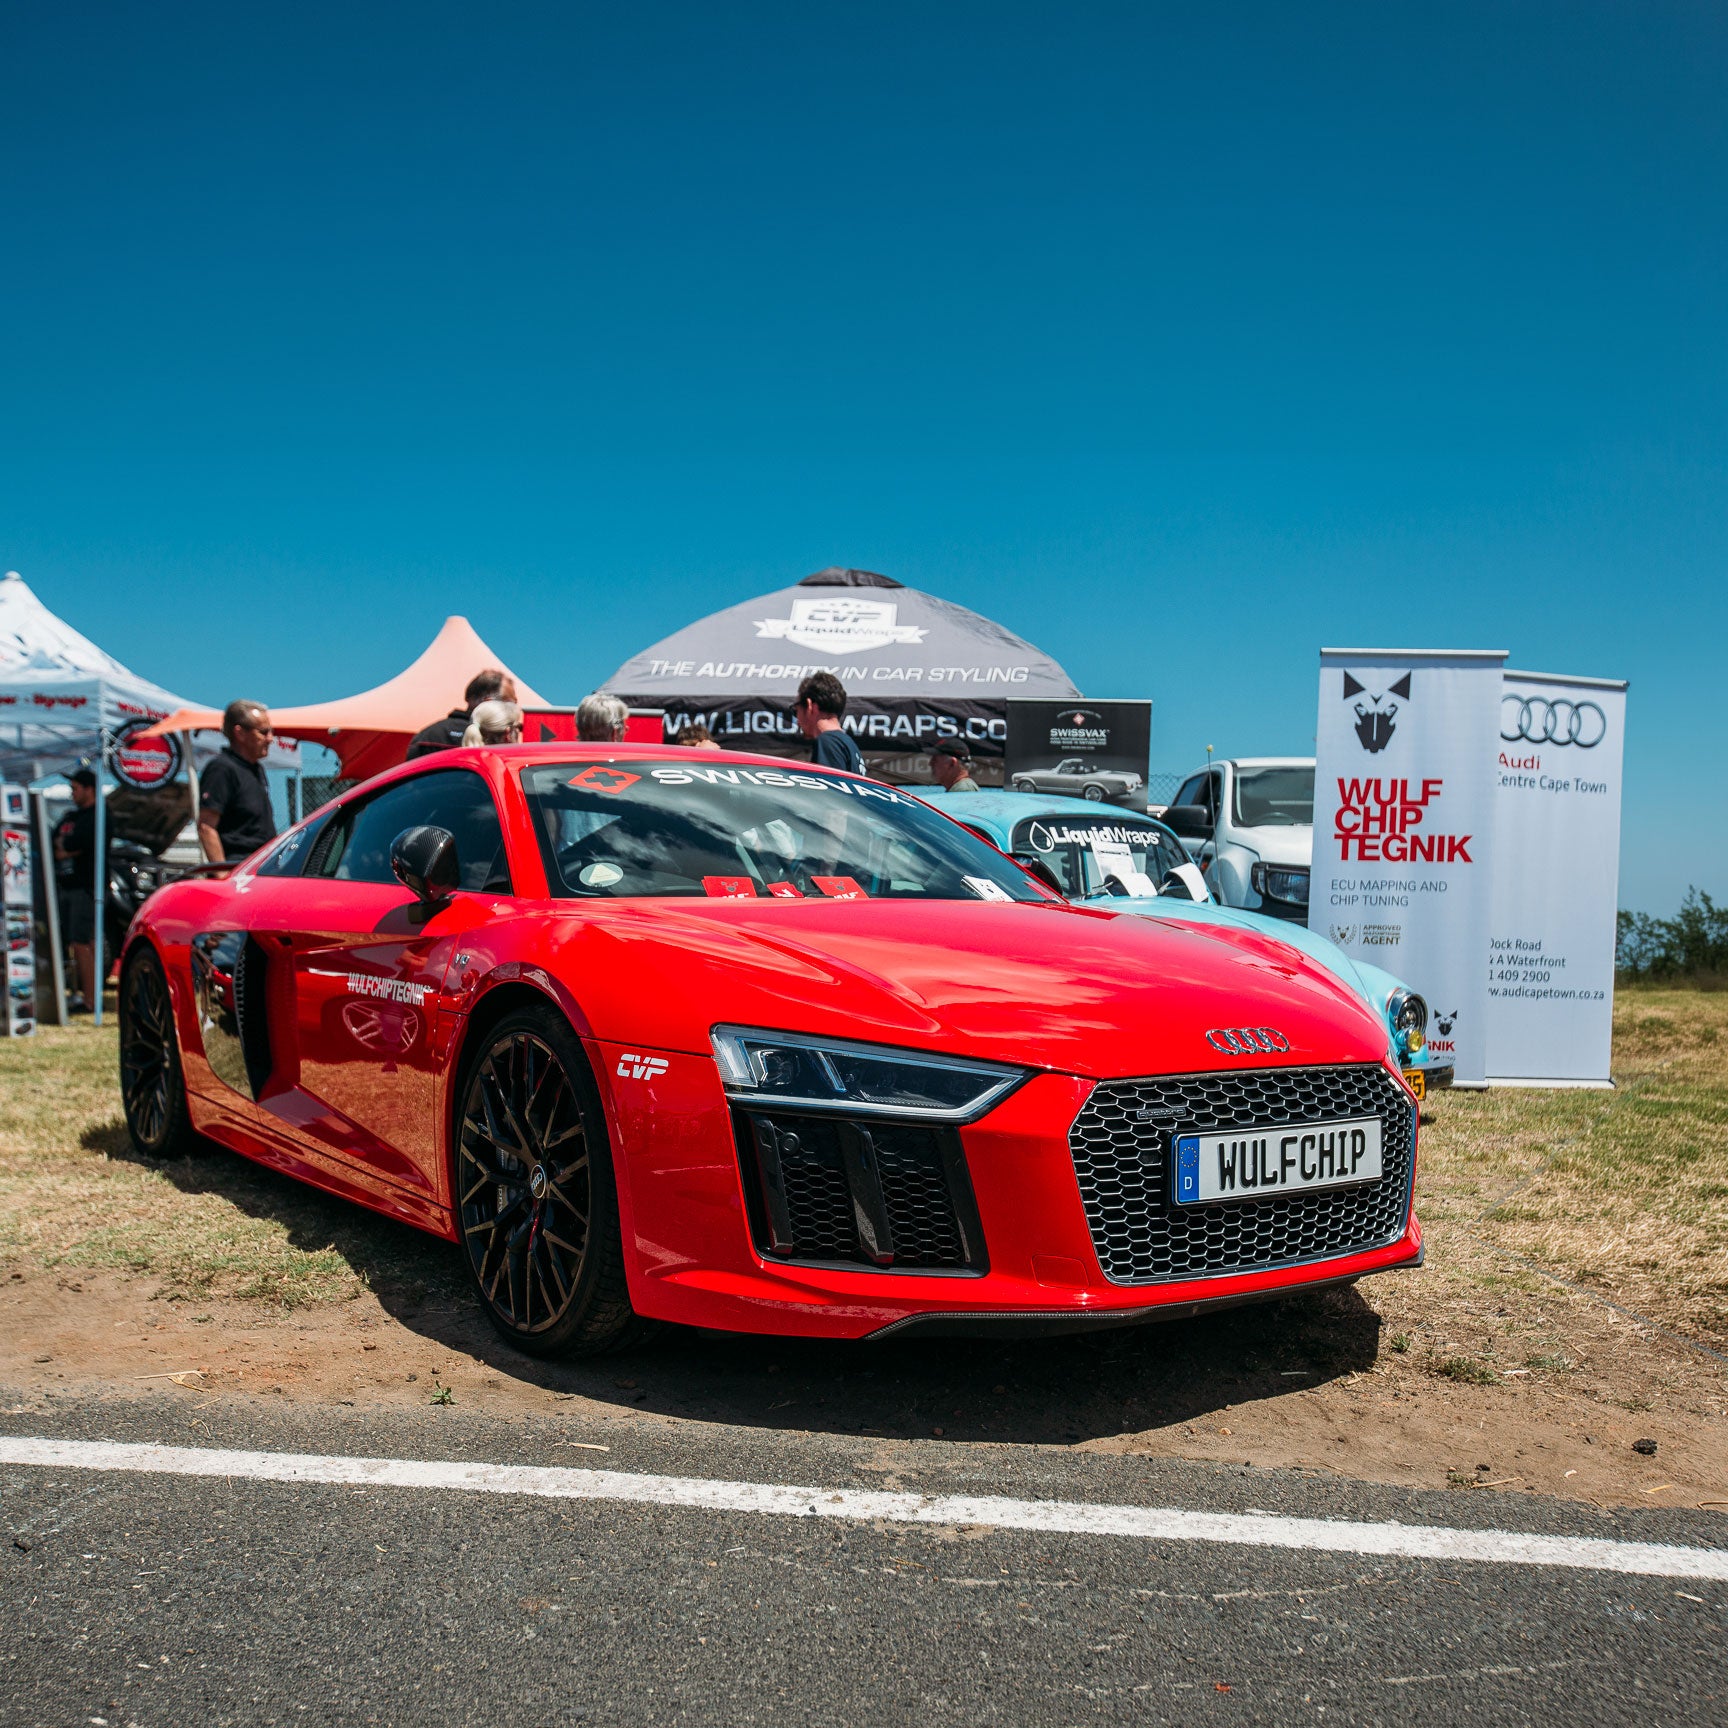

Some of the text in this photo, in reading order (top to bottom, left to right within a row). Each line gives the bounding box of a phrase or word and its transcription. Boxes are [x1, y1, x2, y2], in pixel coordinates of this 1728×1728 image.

[808, 609, 882, 623] CVP
[650, 659, 1029, 683] THE AUTHORITY IN CAR STYLING
[1050, 728, 1107, 738] SWISSVAX
[1498, 752, 1541, 770] Audi
[650, 769, 918, 808] SWISSVAX
[1337, 777, 1443, 806] WULF
[1540, 775, 1570, 793] Cape
[1573, 777, 1607, 794] Town
[1335, 804, 1423, 833] CHIP
[1049, 826, 1159, 847] LiquidWraps
[1334, 833, 1473, 862] TEGNIK
[1331, 879, 1448, 892] ECU MAPPING AND
[1330, 894, 1409, 906] CHIP TUNING
[1362, 936, 1400, 945] AGENT
[1515, 938, 1542, 951] Road
[1496, 954, 1504, 965] A
[1507, 954, 1566, 968] Waterfront
[1497, 969, 1519, 982] 409
[1522, 970, 1550, 982] 2900
[617, 1054, 669, 1080] CVP
[1219, 1128, 1366, 1191] WULFCHIP
[1184, 1176, 1193, 1190] D
